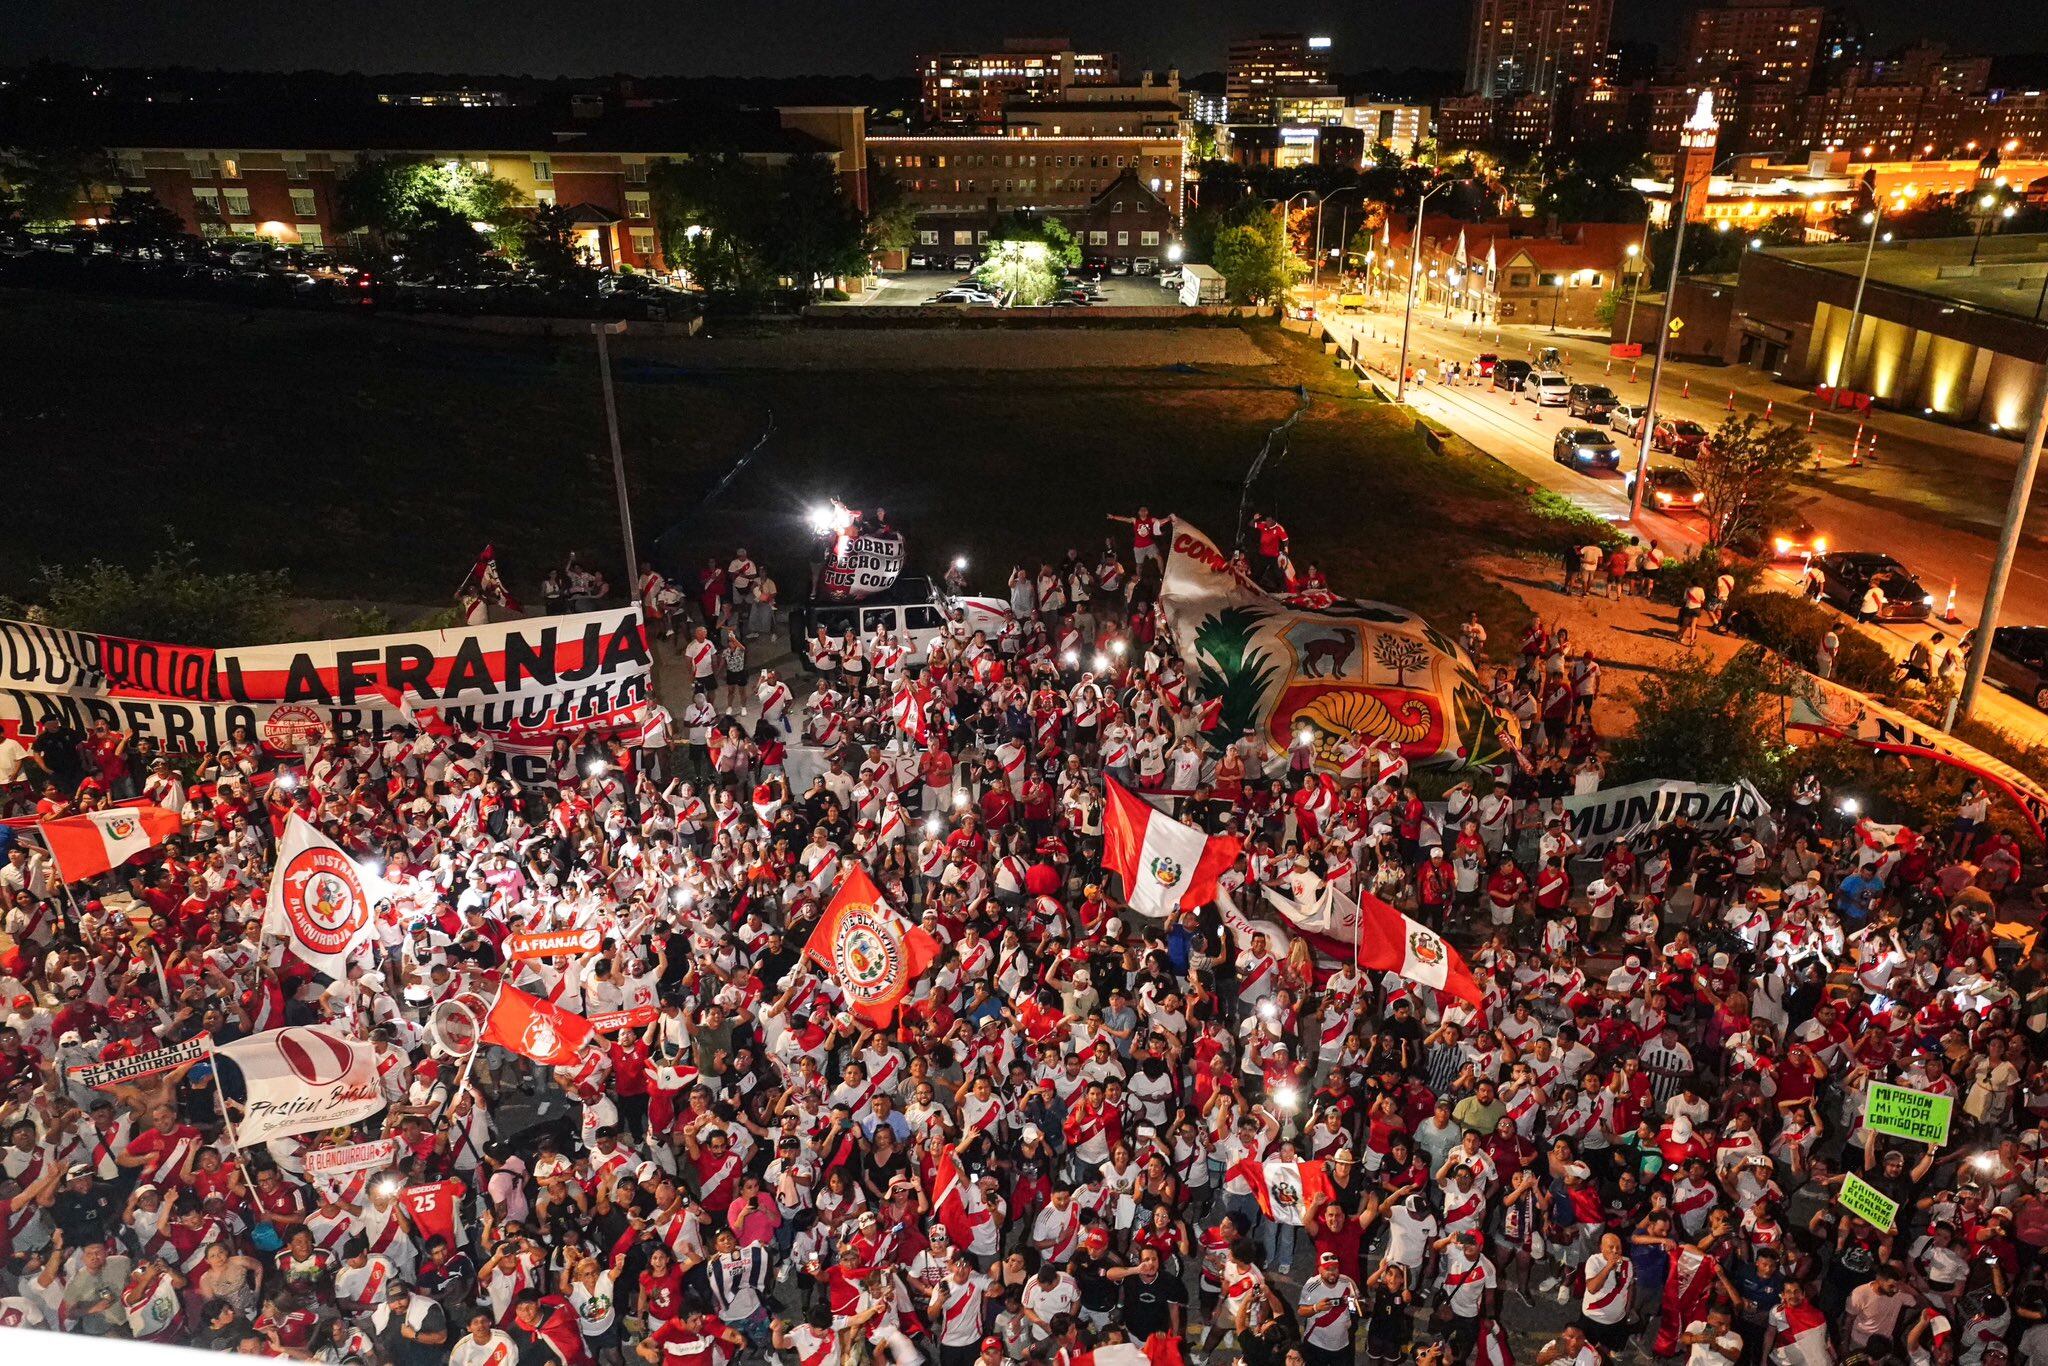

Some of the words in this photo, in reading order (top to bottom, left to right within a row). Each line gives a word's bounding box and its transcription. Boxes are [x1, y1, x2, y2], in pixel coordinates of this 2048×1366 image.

[829, 553, 880, 571] PECHO
[844, 538, 894, 556] SOBRE
[825, 570, 855, 587] TUS
[337, 612, 650, 706] FRANJA
[8, 689, 258, 754] IMPERIO
[290, 898, 352, 946] BLANQUIRROJA
[513, 940, 530, 952] LA
[533, 935, 579, 949] FRANJA
[81, 1038, 200, 1077] SENTIMIENTO
[83, 1047, 202, 1087] BLANQUIRROJO
[414, 1193, 436, 1213] 25
[1851, 1180, 1893, 1211] GRIMALDO
